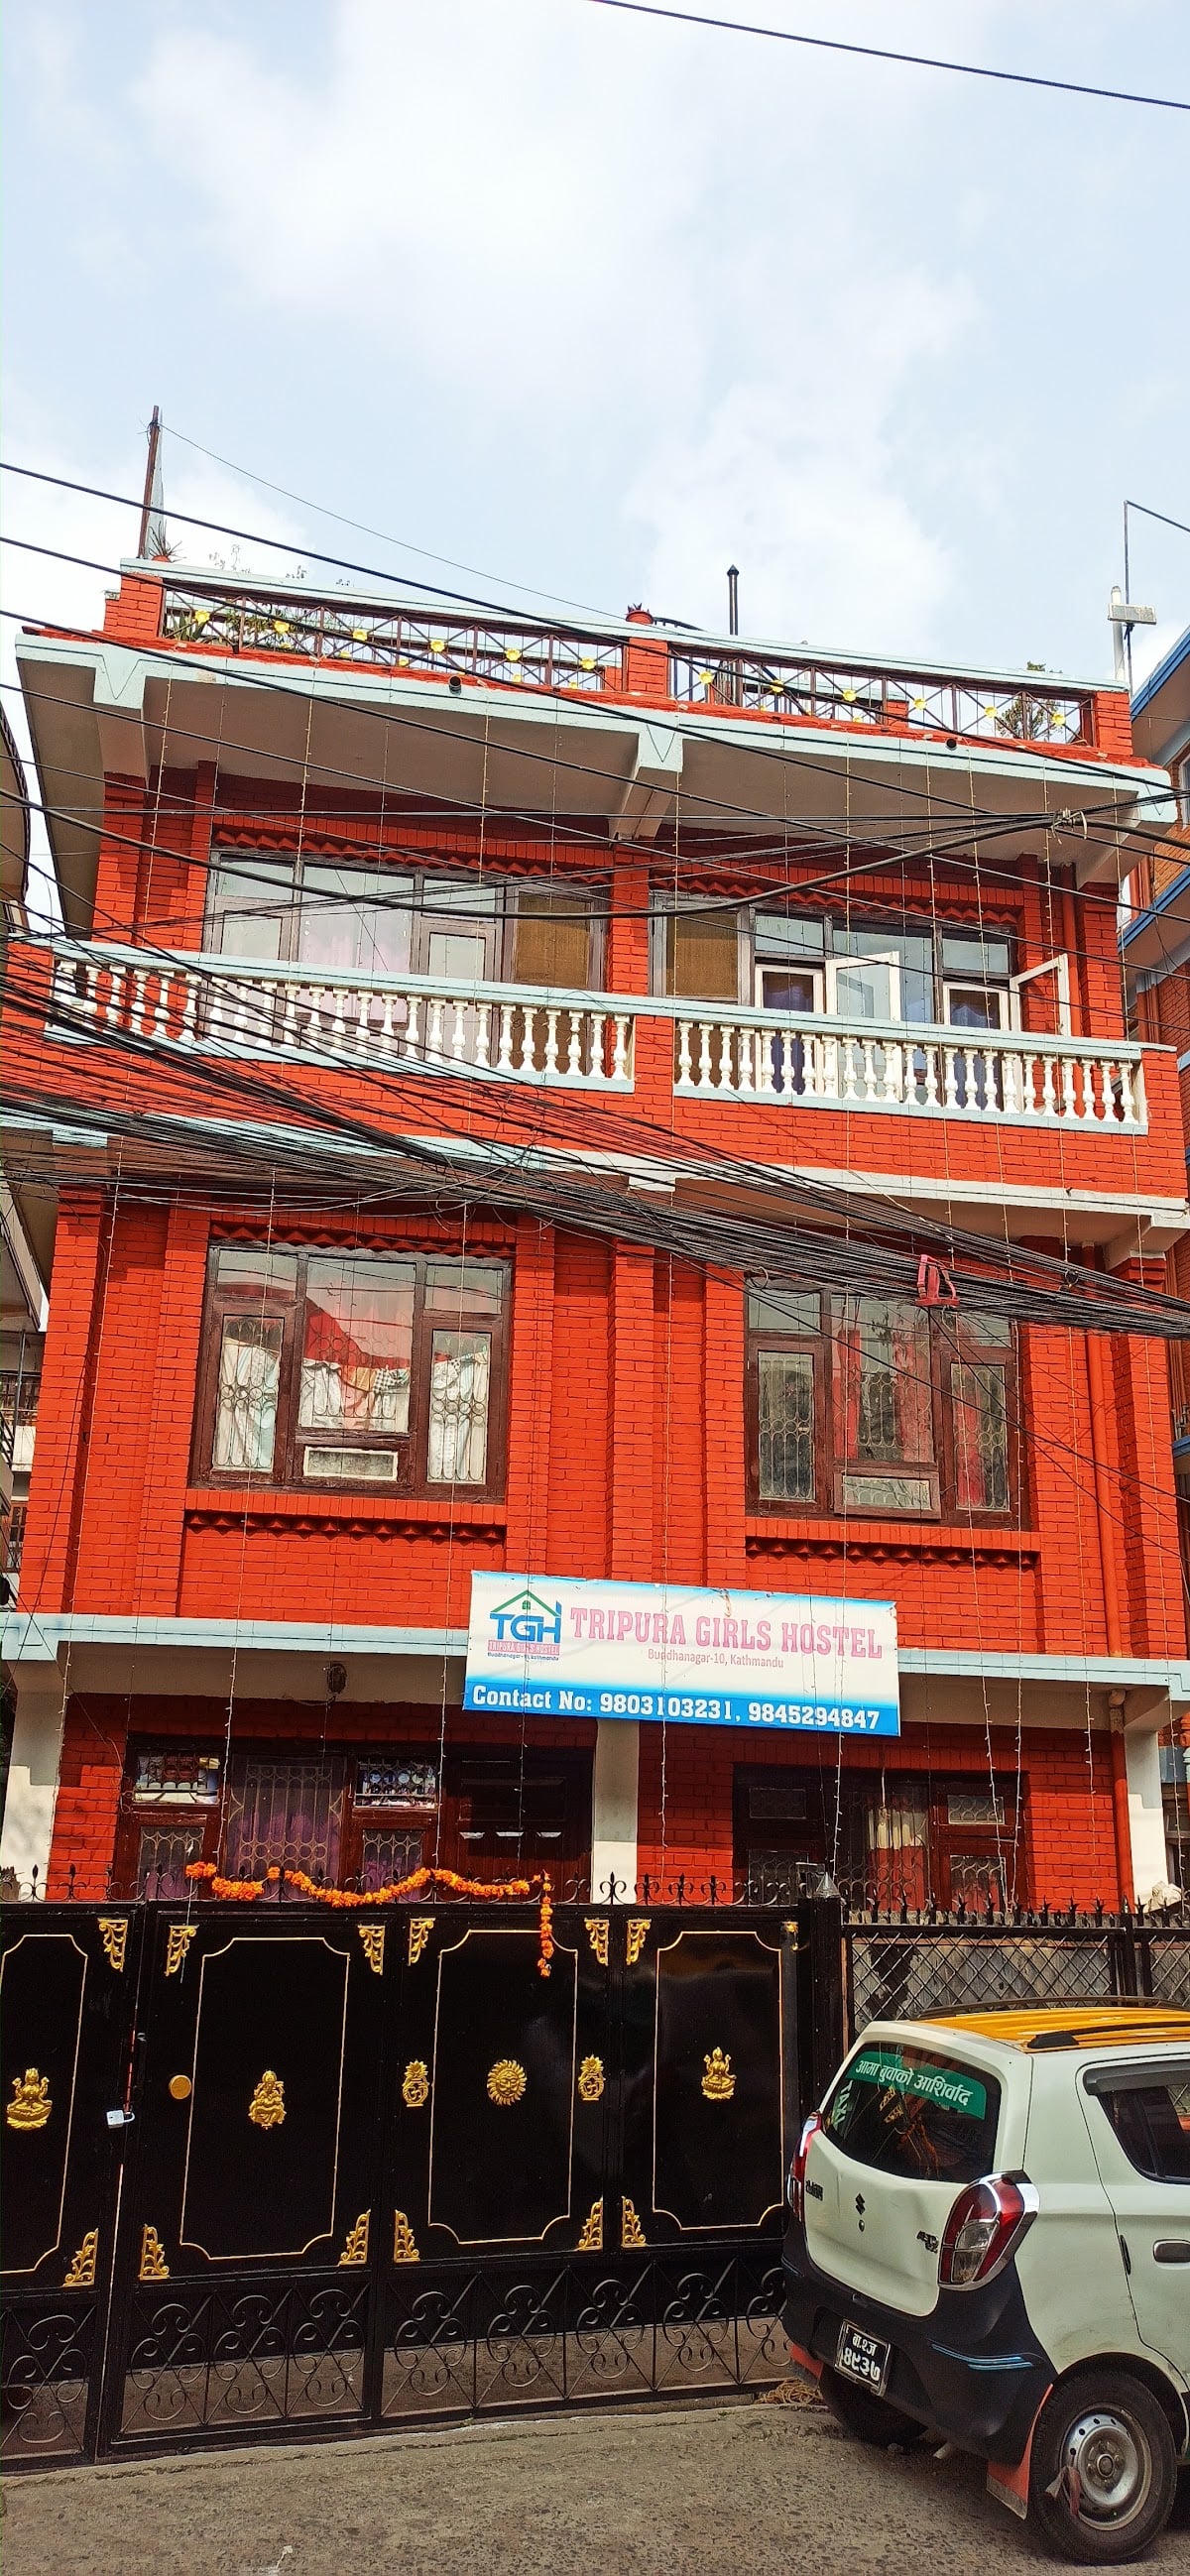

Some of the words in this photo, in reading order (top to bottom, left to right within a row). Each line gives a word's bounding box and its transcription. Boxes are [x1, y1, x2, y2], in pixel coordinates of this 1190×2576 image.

[490, 1600, 562, 1643] TGH
[570, 1607, 686, 1645] TRIPURA
[695, 1615, 772, 1651] GIRLS
[781, 1622, 883, 1659] HOSTEL
[648, 1648, 728, 1667] Buddhanagar-10,
[730, 1654, 784, 1668] Kathmandu
[473, 1685, 551, 1709] Contact
[558, 1690, 592, 1711] No:
[599, 1693, 741, 1722] 9803103231,
[749, 1701, 880, 1729] 9845294847
[856, 2060, 881, 2077] आमा
[913, 2074, 974, 2106] आशिर्वाद
